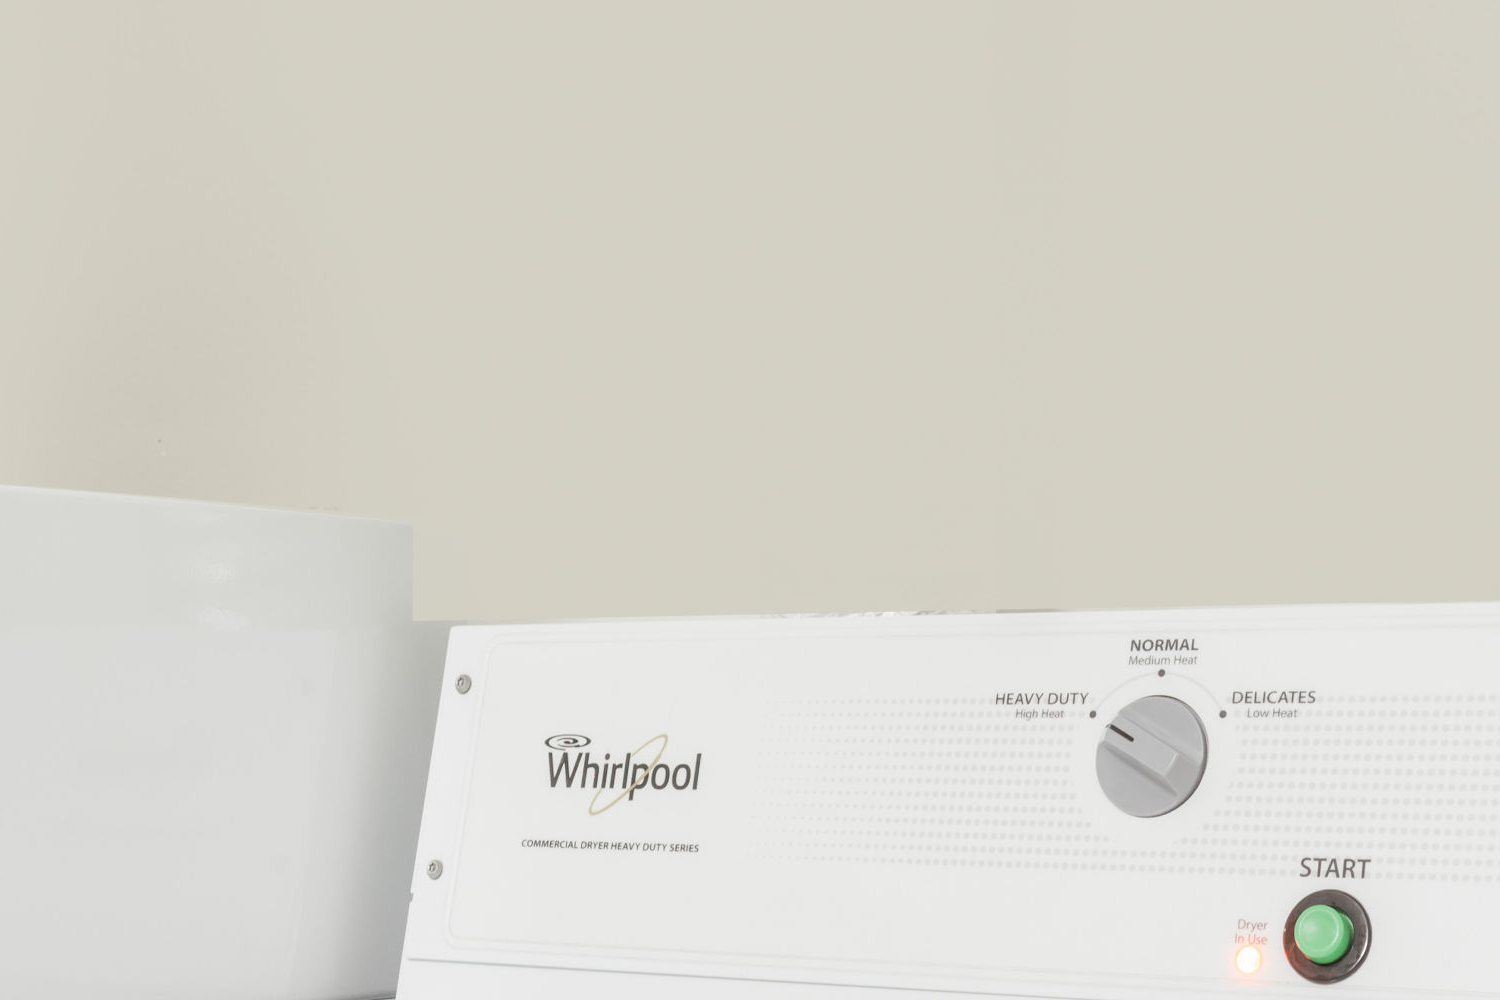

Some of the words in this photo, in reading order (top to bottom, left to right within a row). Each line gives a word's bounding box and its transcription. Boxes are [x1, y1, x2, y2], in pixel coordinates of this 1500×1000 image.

[1130, 638, 1199, 652] NORMAL
[1128, 654, 1171, 666] Medium
[1174, 654, 1198, 666] Heat
[995, 692, 1044, 706] HEAVY
[1047, 692, 1089, 705] DUTY
[1232, 690, 1317, 704] DELICATES
[1015, 708, 1039, 721] High
[1041, 708, 1065, 719] Heat
[1246, 708, 1273, 719] Low
[1275, 708, 1298, 719] Heat
[548, 752, 702, 801] Whirlpool
[521, 839, 578, 849] COMMERCIAL
[580, 840, 609, 850] DRYER
[610, 841, 640, 851] HEAVY
[642, 842, 668, 852] DUTY
[669, 843, 700, 853] SERIES
[1299, 857, 1371, 879] START
[1237, 918, 1268, 932] Dryer
[1234, 933, 1245, 944] In
[1247, 934, 1268, 945] Use
